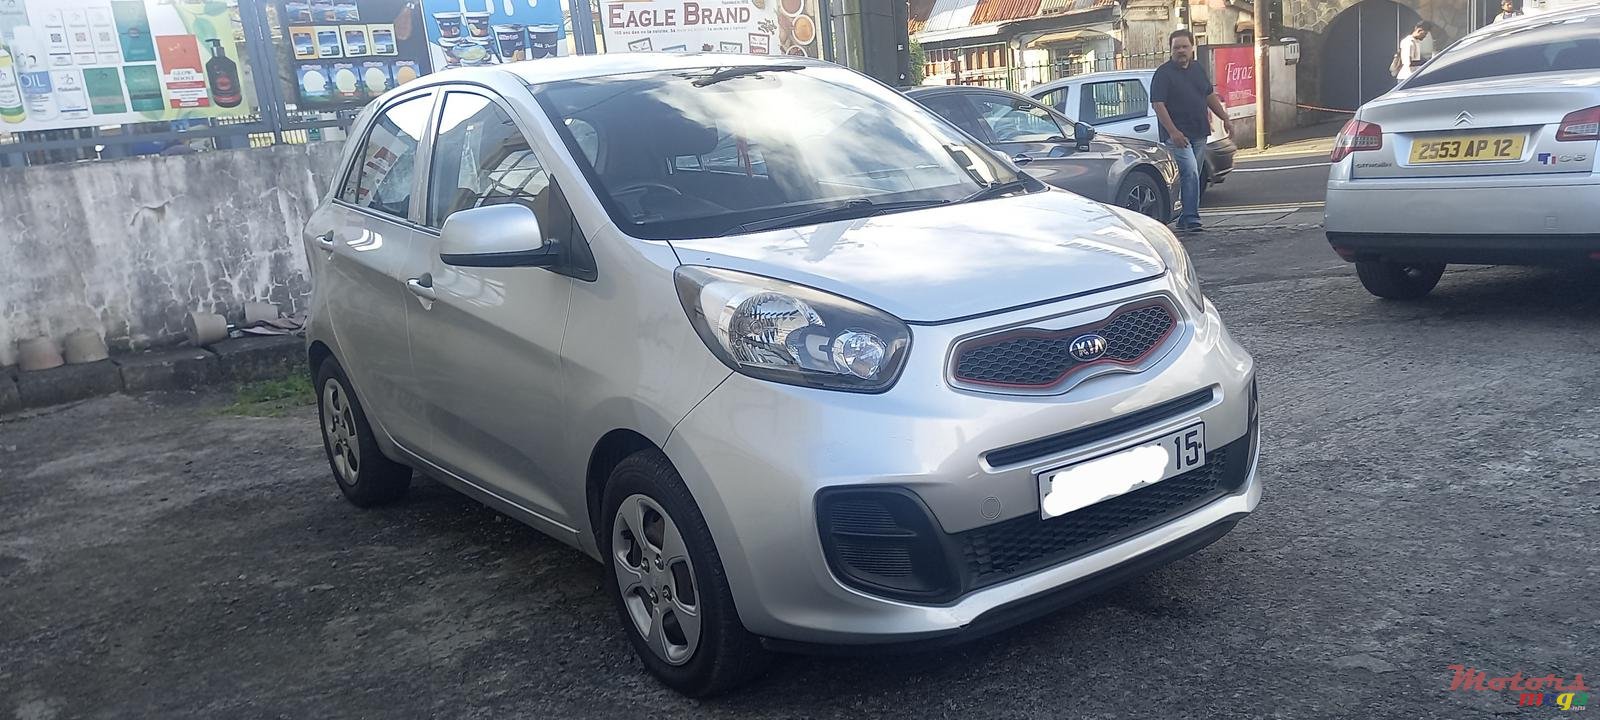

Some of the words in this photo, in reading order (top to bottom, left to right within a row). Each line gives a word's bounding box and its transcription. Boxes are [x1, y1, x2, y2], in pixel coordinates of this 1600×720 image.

[608, 4, 676, 28] EAGLE
[684, 2, 750, 25] BRAND
[20, 74, 47, 88] OIL
[1225, 62, 1253, 84] Feraz
[1419, 141, 1460, 159] 2553
[1463, 140, 1488, 157] AP
[1493, 139, 1513, 156] 12
[1075, 339, 1104, 356] KIA
[1174, 429, 1199, 470] 15
